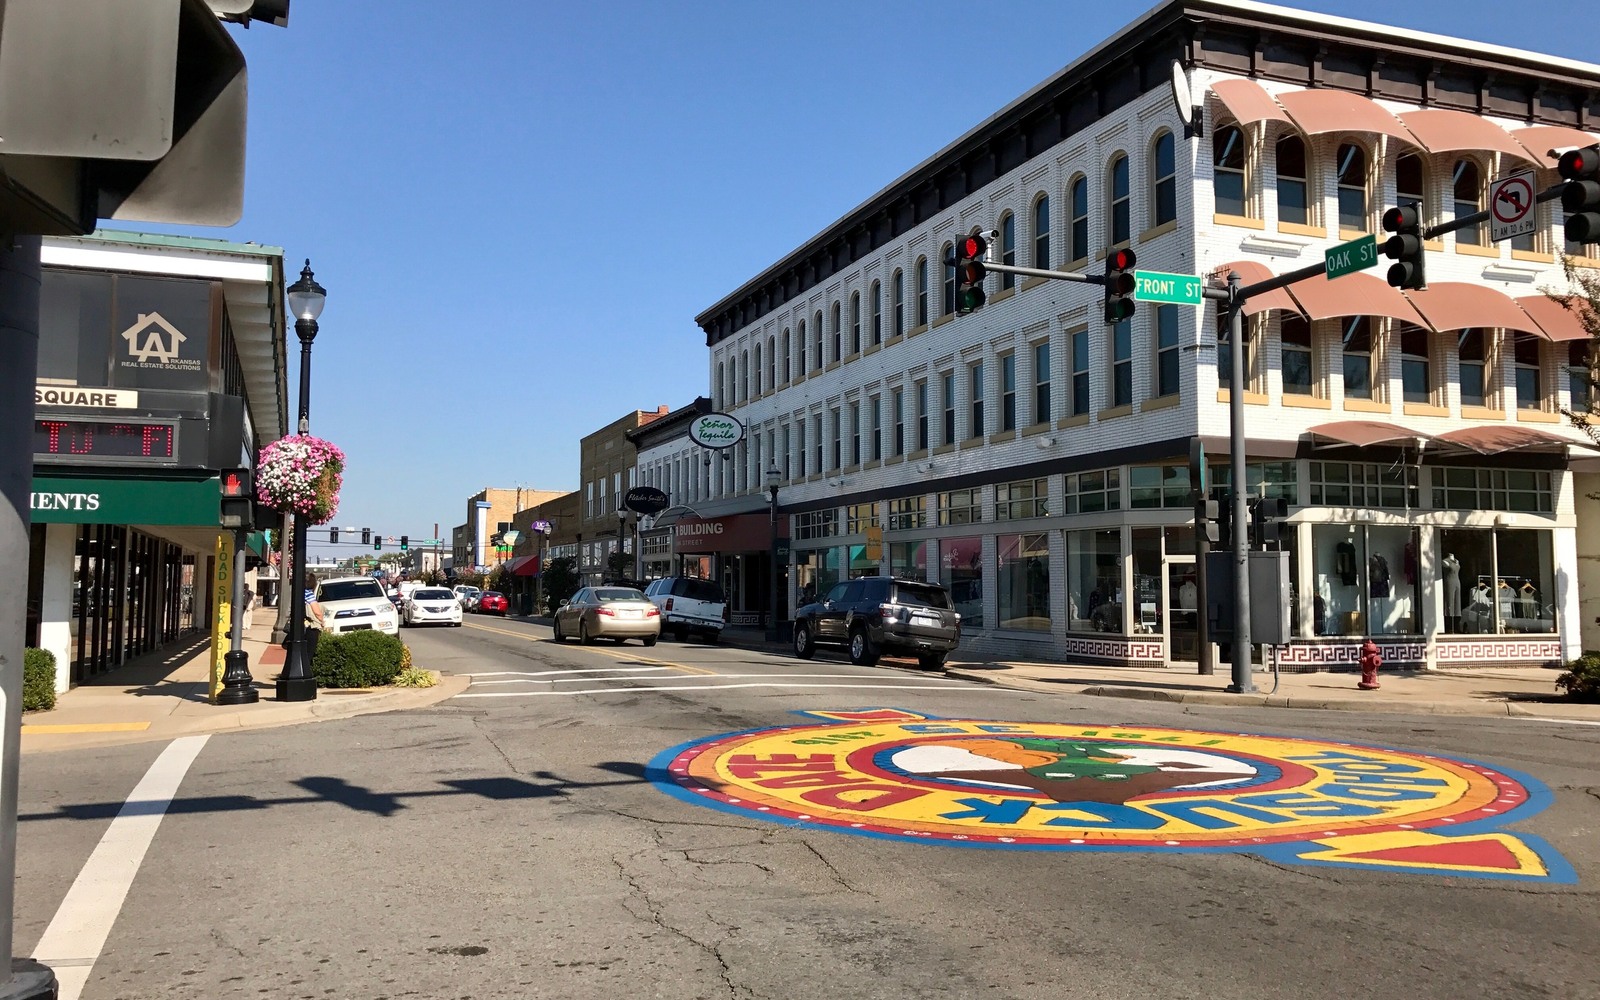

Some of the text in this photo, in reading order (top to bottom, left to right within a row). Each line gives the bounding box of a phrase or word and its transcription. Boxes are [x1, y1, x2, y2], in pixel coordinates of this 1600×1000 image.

[1501, 227, 1508, 236] AM
[1510, 224, 1517, 233] TO
[1526, 220, 1534, 230] PM
[1327, 242, 1375, 272] OAK ST
[1136, 277, 1200, 298] FRONT ST
[164, 363, 201, 371] SOLUTIONS
[35, 390, 117, 407] SQUARE
[699, 417, 735, 430] Señor
[698, 429, 736, 442] Tequila
[679, 522, 724, 536] BUILDING
[218, 542, 228, 581] TOAD
[217, 586, 227, 624] SUCK
[726, 752, 935, 812] DAZE
[936, 792, 1391, 830] SUCK
